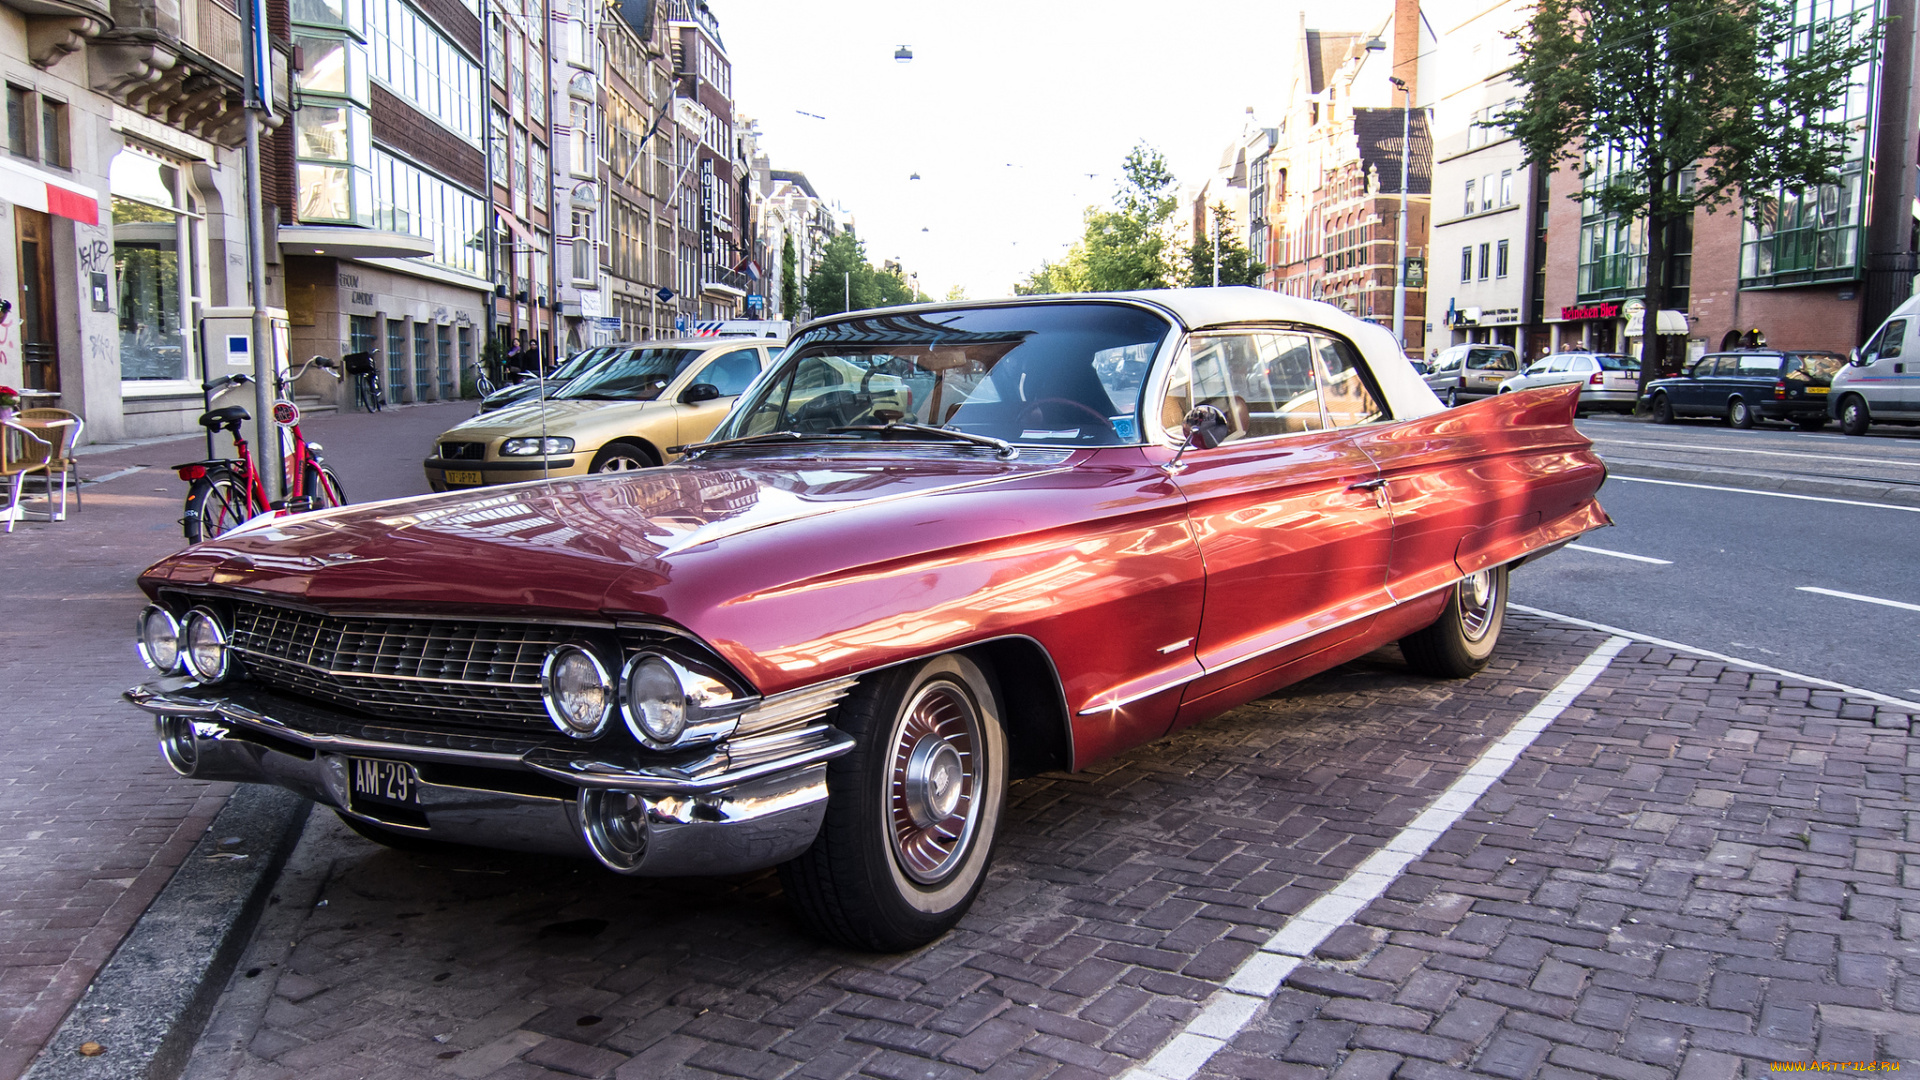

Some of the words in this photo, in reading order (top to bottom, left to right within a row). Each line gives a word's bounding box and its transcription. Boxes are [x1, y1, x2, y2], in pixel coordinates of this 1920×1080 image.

[1561, 304, 1599, 320] Heineken
[1600, 302, 1618, 318] Bier
[356, 759, 421, 804] AM-29-
